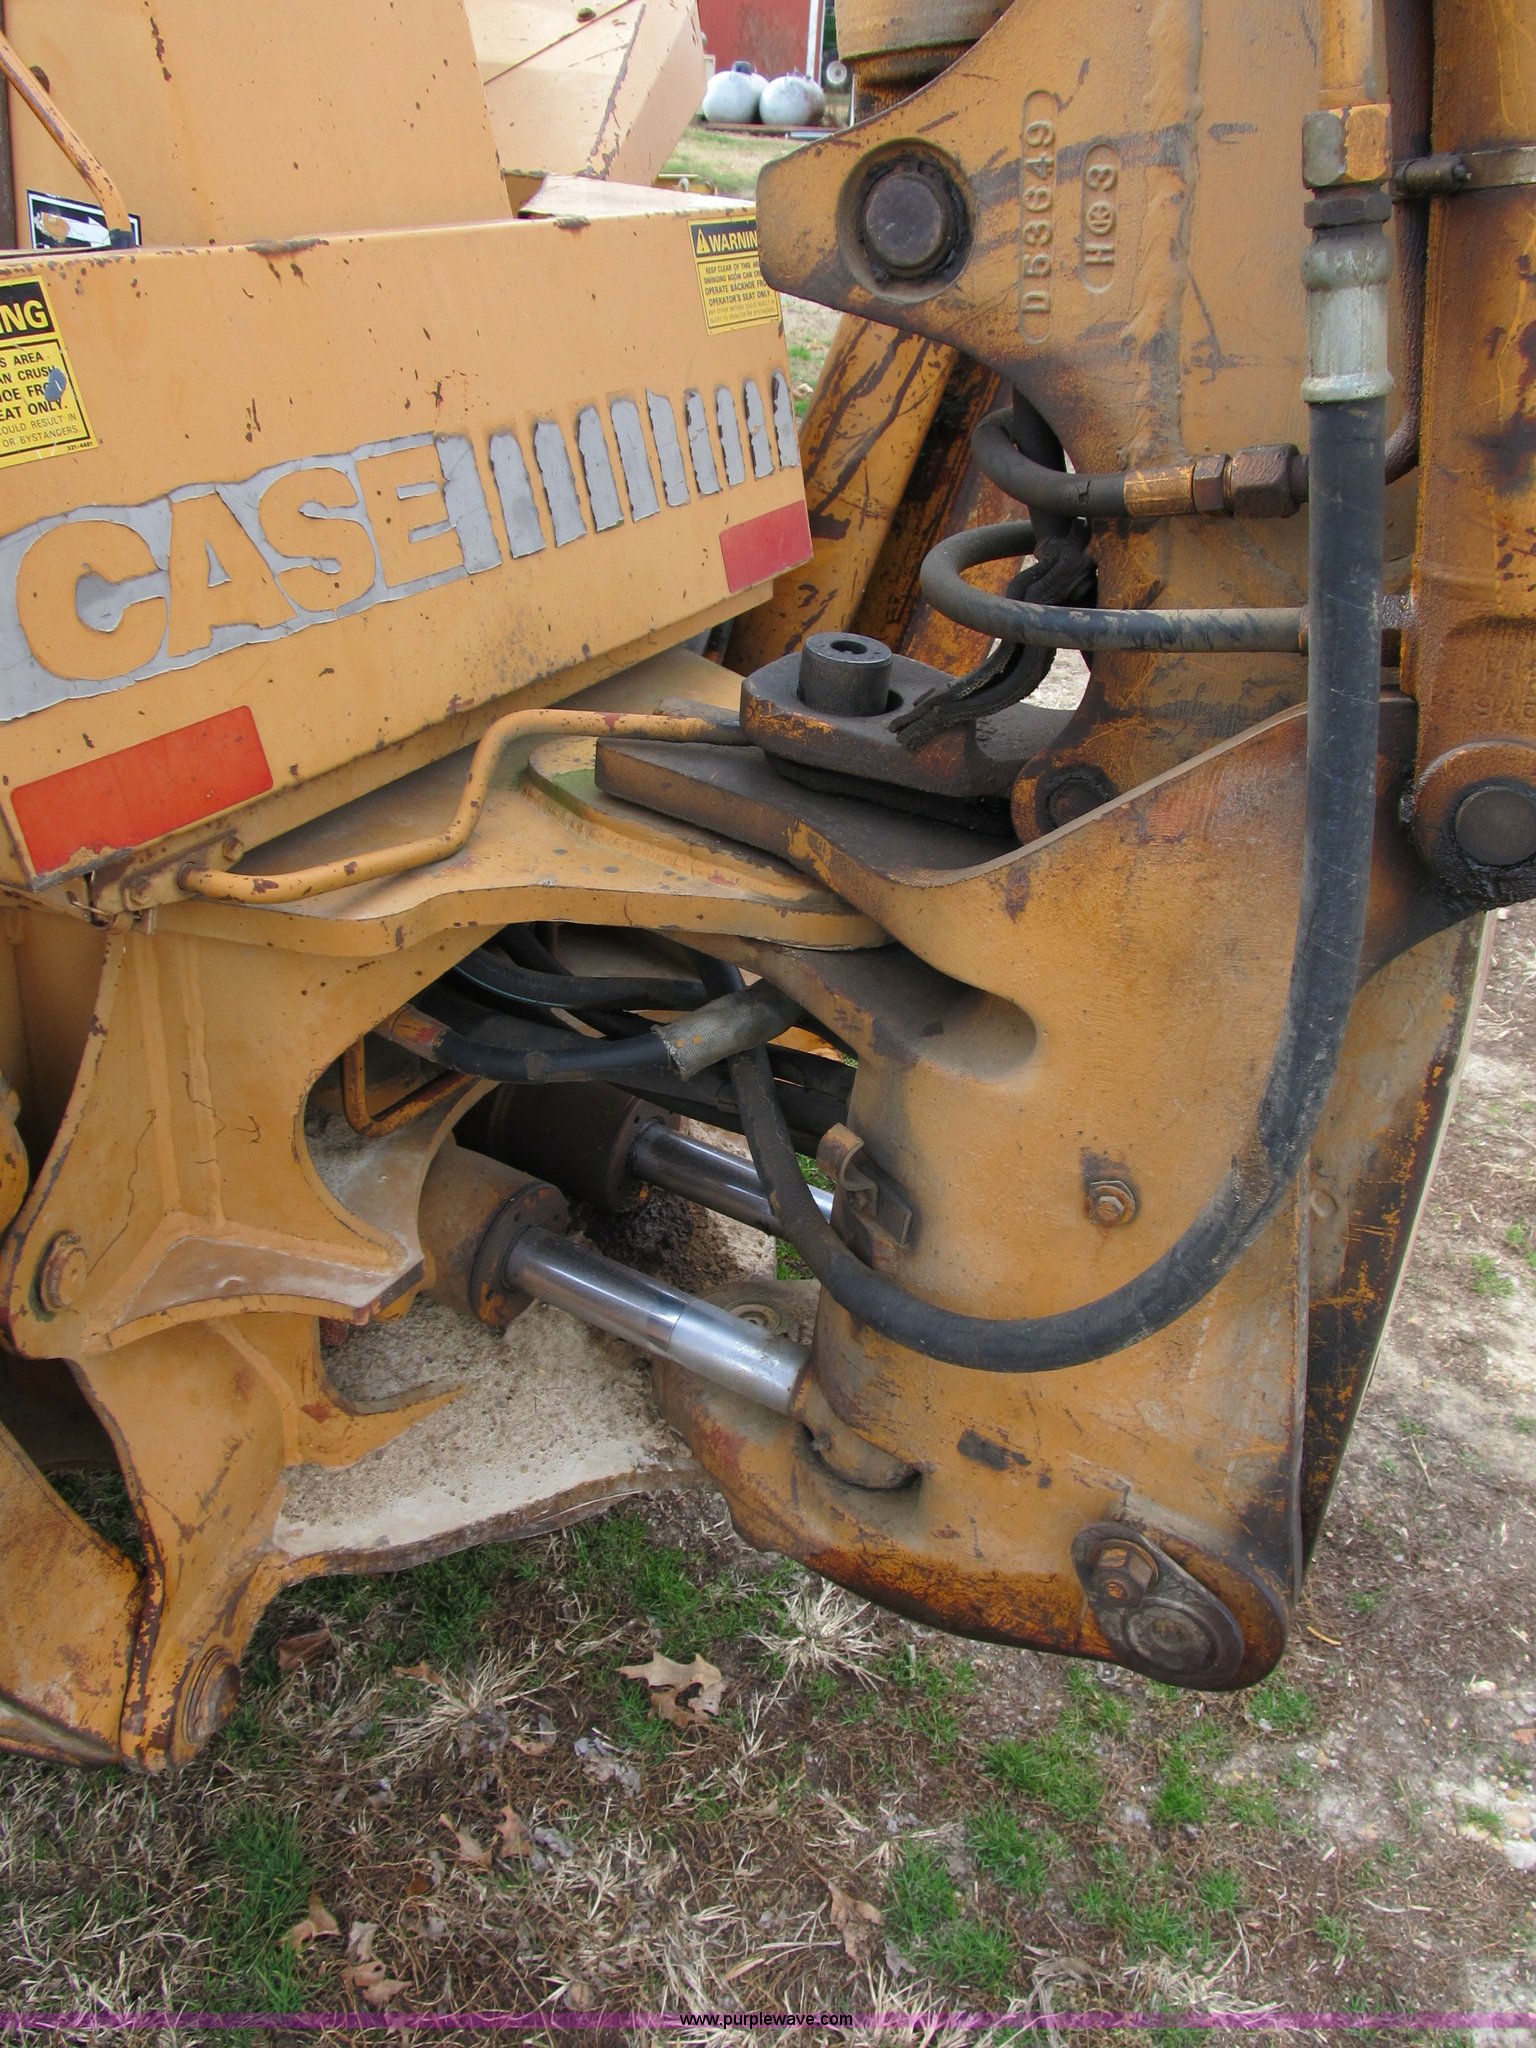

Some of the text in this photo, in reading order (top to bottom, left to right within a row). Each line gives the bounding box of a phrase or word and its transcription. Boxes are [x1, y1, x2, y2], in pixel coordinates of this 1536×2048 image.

[708, 230, 758, 253] WARNIN
[717, 264, 732, 273] CLEAR
[740, 262, 751, 270] THIS
[742, 271, 753, 279] CAN
[704, 284, 729, 296] OPERATE
[730, 280, 755, 292] BACKHOE
[742, 291, 756, 301] SEAT
[31, 415, 64, 430] RESULT
[68, 412, 77, 422] IN
[2, 437, 16, 448] OR
[15, 443, 467, 681] CASE
